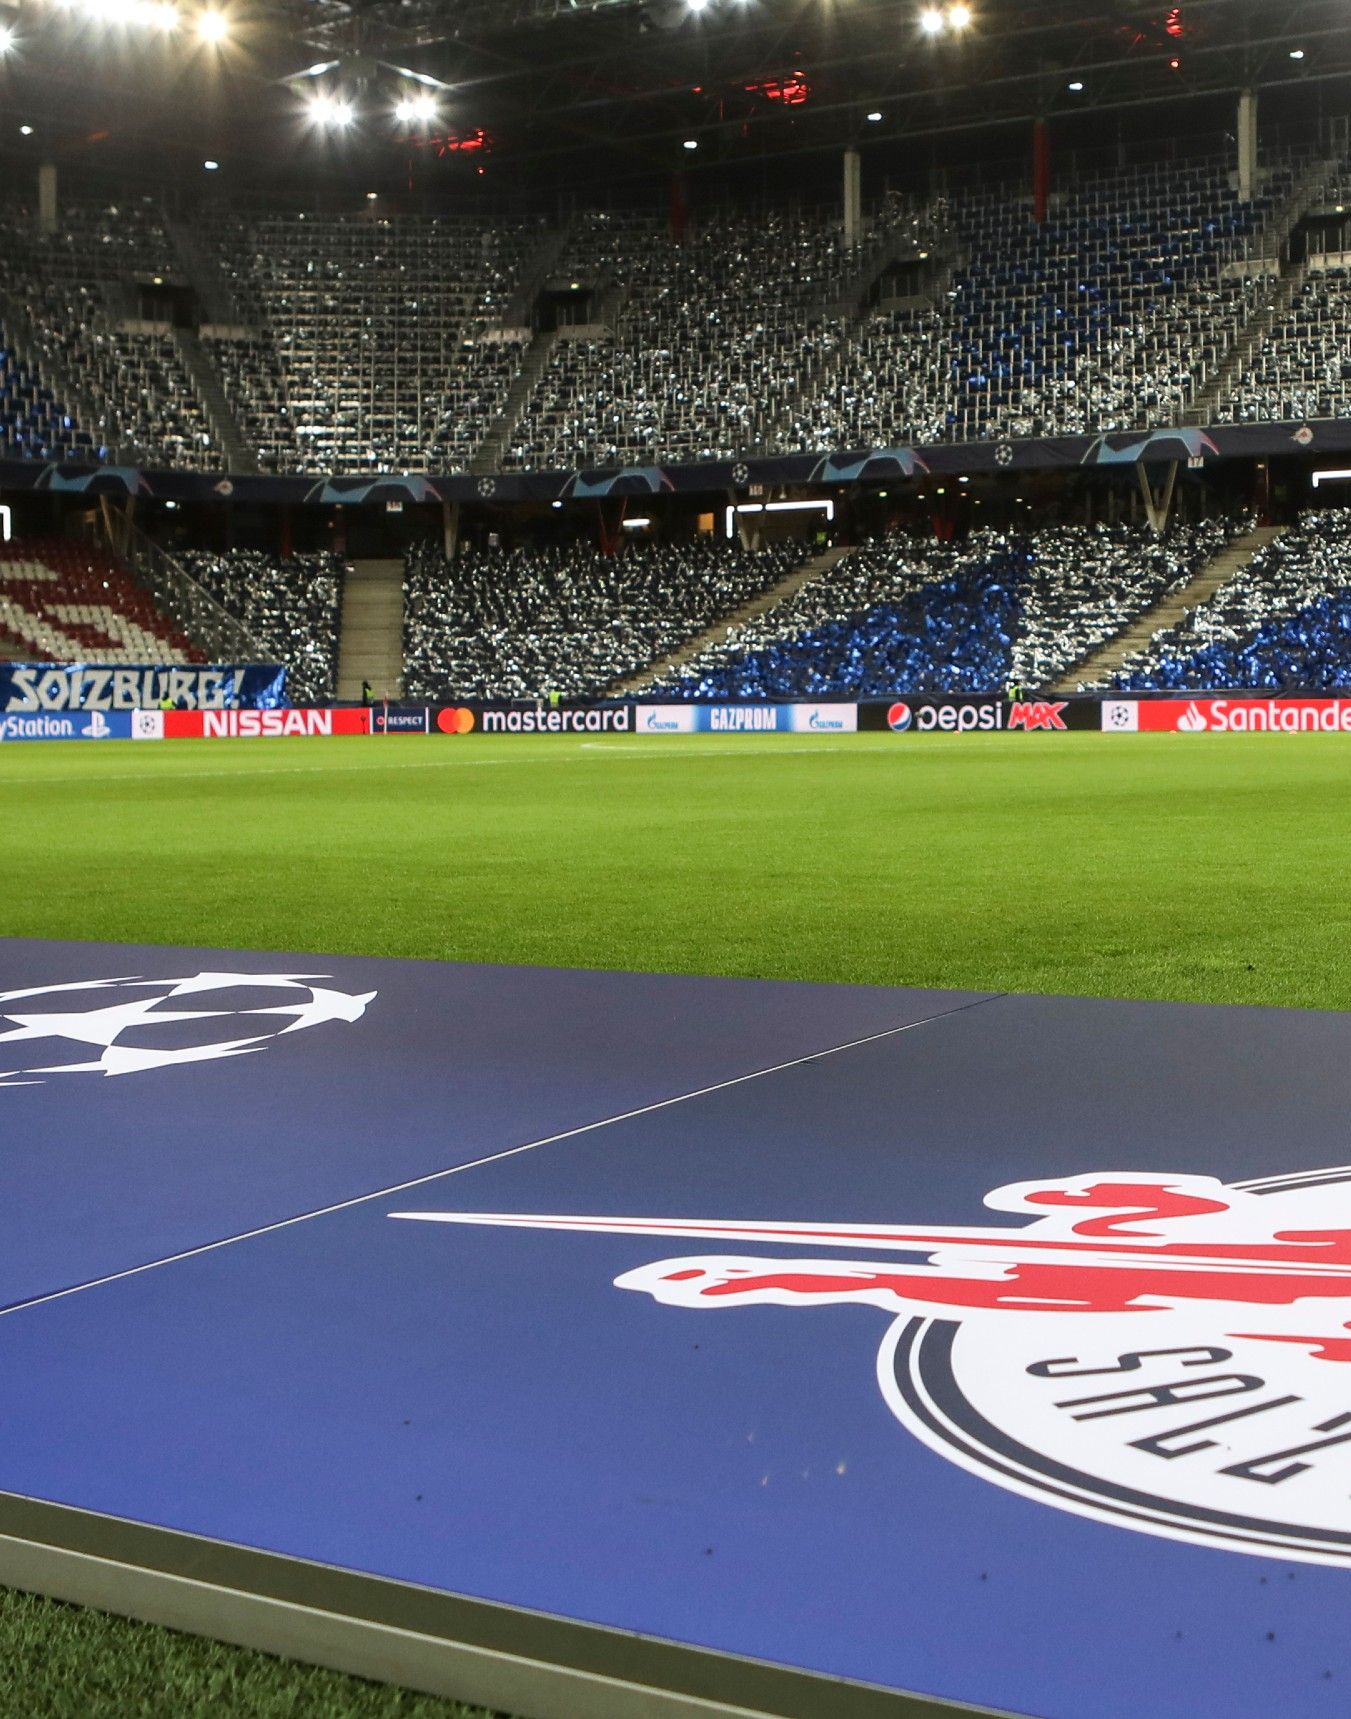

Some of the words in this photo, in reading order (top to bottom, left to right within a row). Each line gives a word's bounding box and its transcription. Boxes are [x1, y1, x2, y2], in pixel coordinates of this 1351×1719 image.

[203, 710, 332, 736] NISSAN
[388, 716, 423, 726] RESPECT
[483, 705, 629, 732] mastercard
[710, 708, 776, 730] GAZPROM
[916, 702, 1003, 731] pepsi
[1007, 702, 1069, 731] MAX
